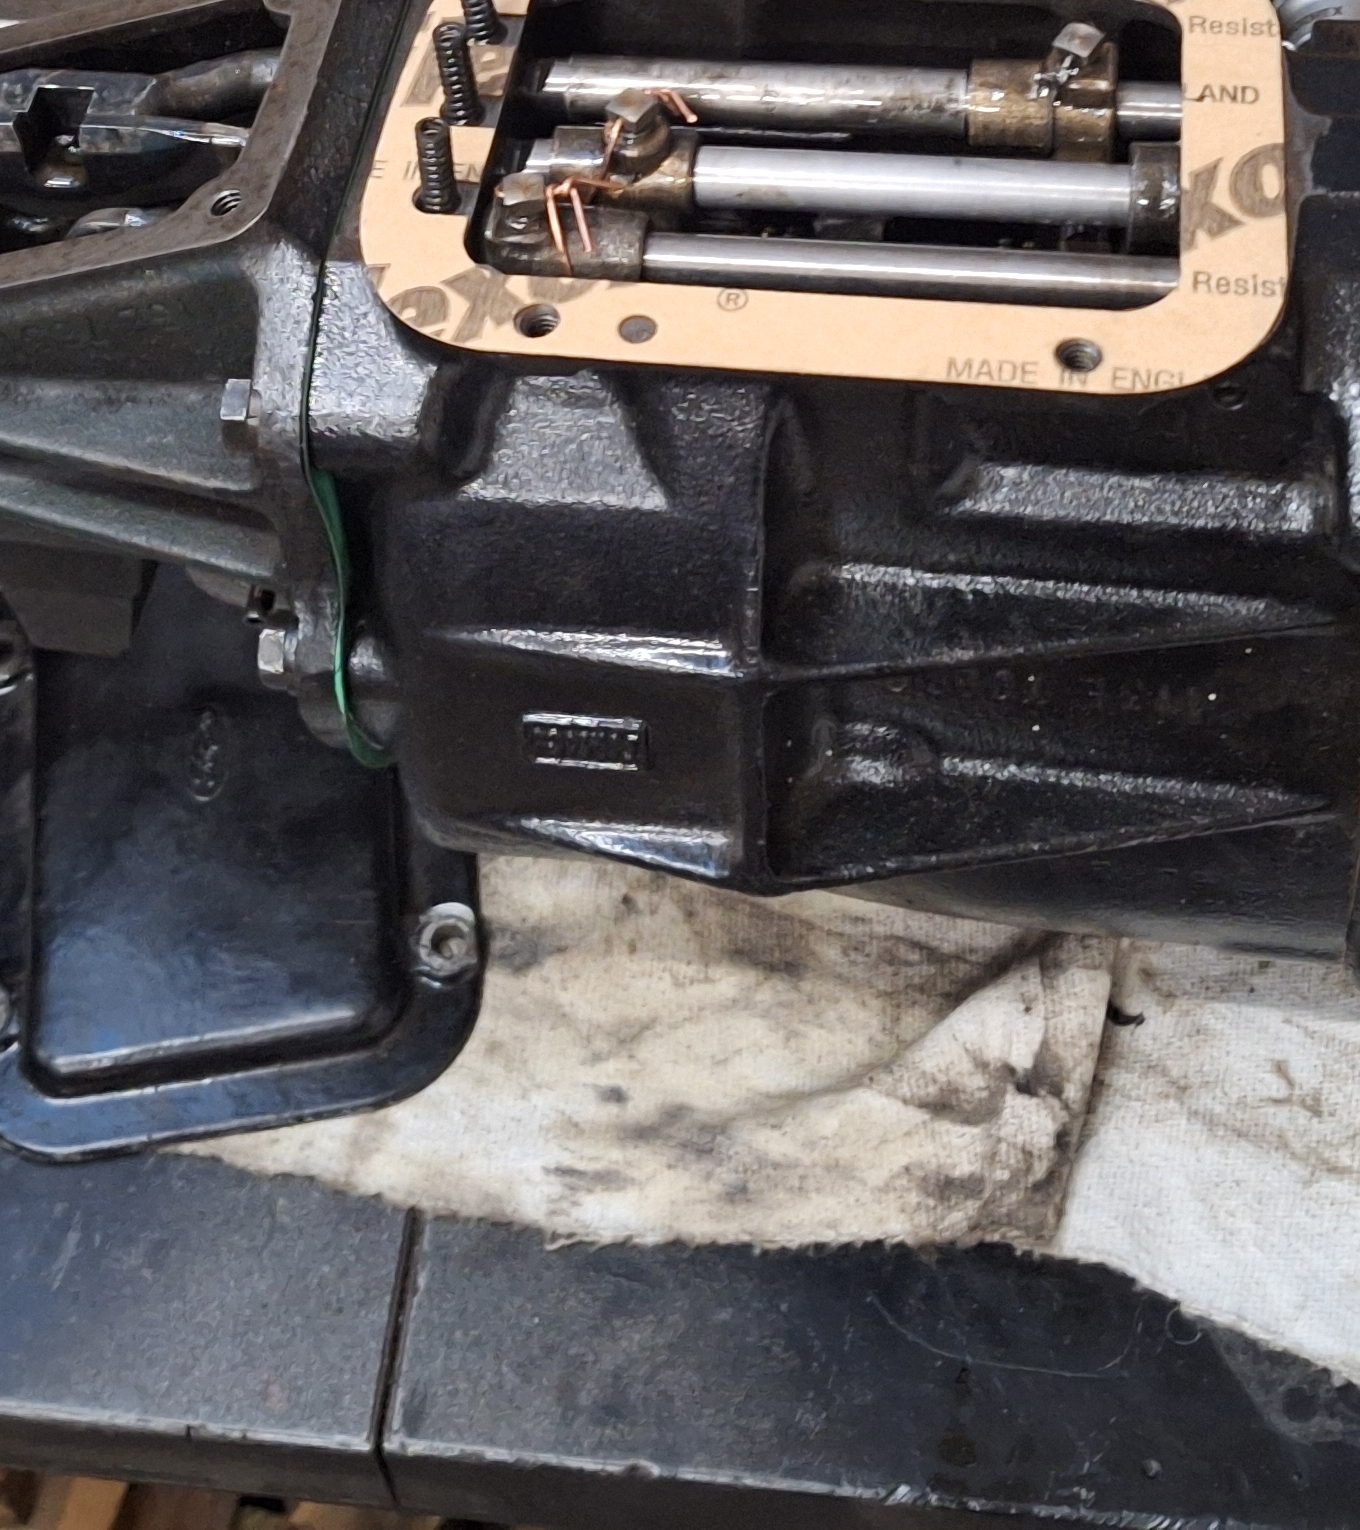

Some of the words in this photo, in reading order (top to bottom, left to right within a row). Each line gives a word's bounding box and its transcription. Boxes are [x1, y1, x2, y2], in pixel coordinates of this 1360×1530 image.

[1189, 15, 1279, 38] Resist
[945, 357, 1040, 385] MADE
[1057, 366, 1091, 387] IN
